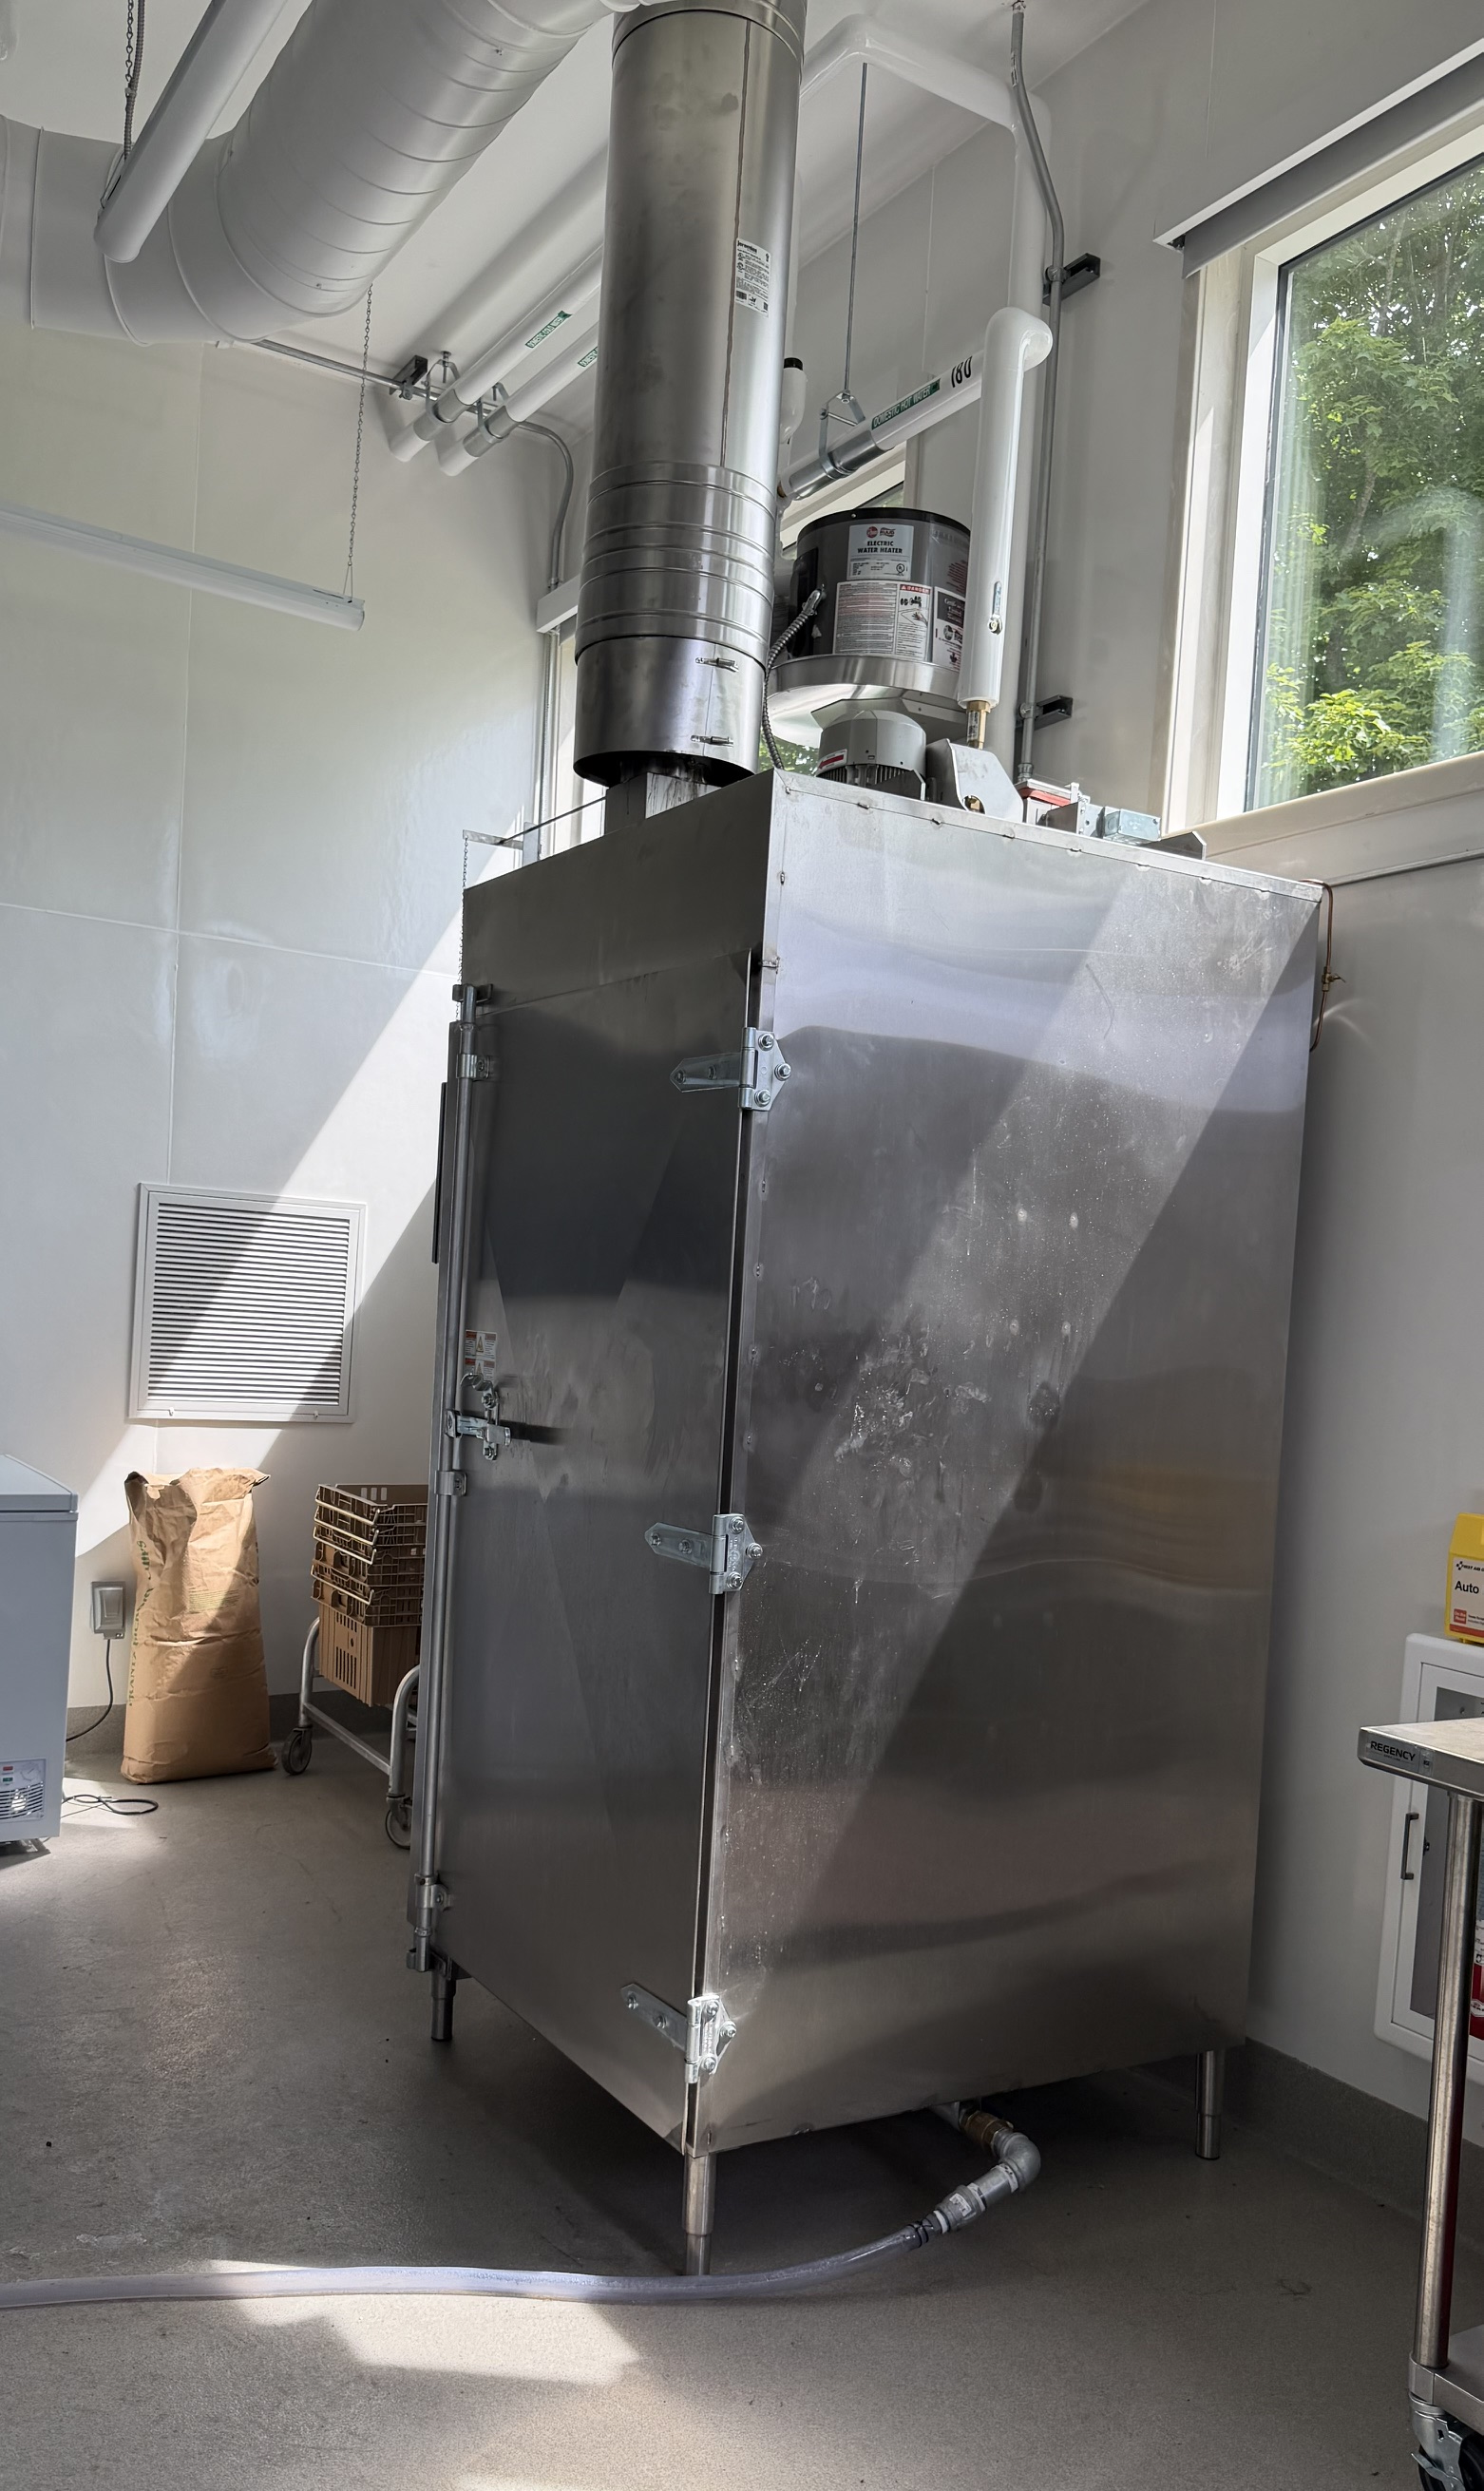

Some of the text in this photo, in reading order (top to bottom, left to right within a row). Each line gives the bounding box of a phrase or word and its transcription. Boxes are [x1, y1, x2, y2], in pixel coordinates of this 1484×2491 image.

[951, 355, 973, 388] 180
[873, 385, 931, 428] DOMESTIC HOT WATER
[1455, 1581, 1479, 1594] Auto
[1370, 1740, 1416, 1761] REGENCY
